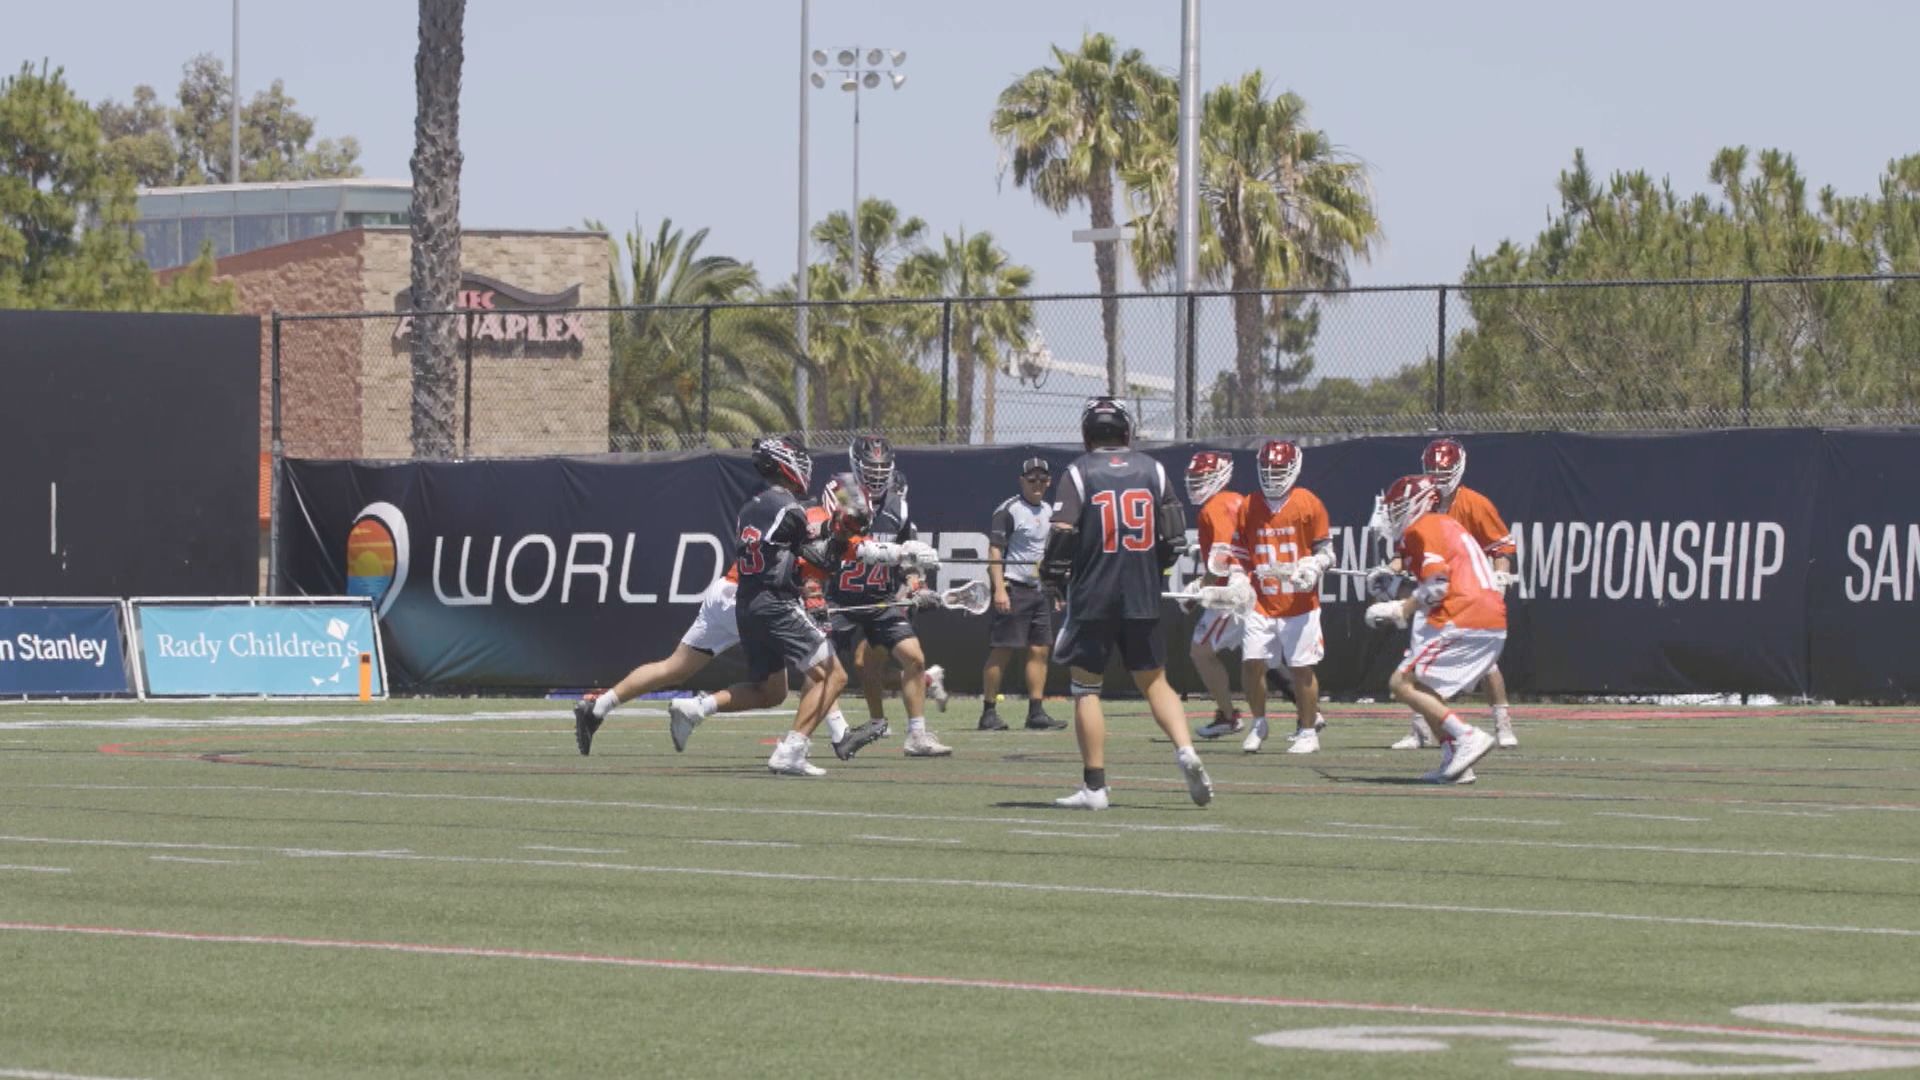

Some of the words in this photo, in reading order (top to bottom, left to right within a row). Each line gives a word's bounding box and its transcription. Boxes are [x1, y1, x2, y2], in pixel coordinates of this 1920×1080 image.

[457, 290, 496, 309] TEC
[396, 313, 585, 341] AUAPLEX
[1091, 487, 1155, 554] 19
[433, 532, 724, 605] WORLD
[1508, 520, 1785, 601] AMPIONSHIP
[840, 559, 891, 592] 24
[17, 633, 107, 667] Stanley
[157, 634, 221, 663] Rady
